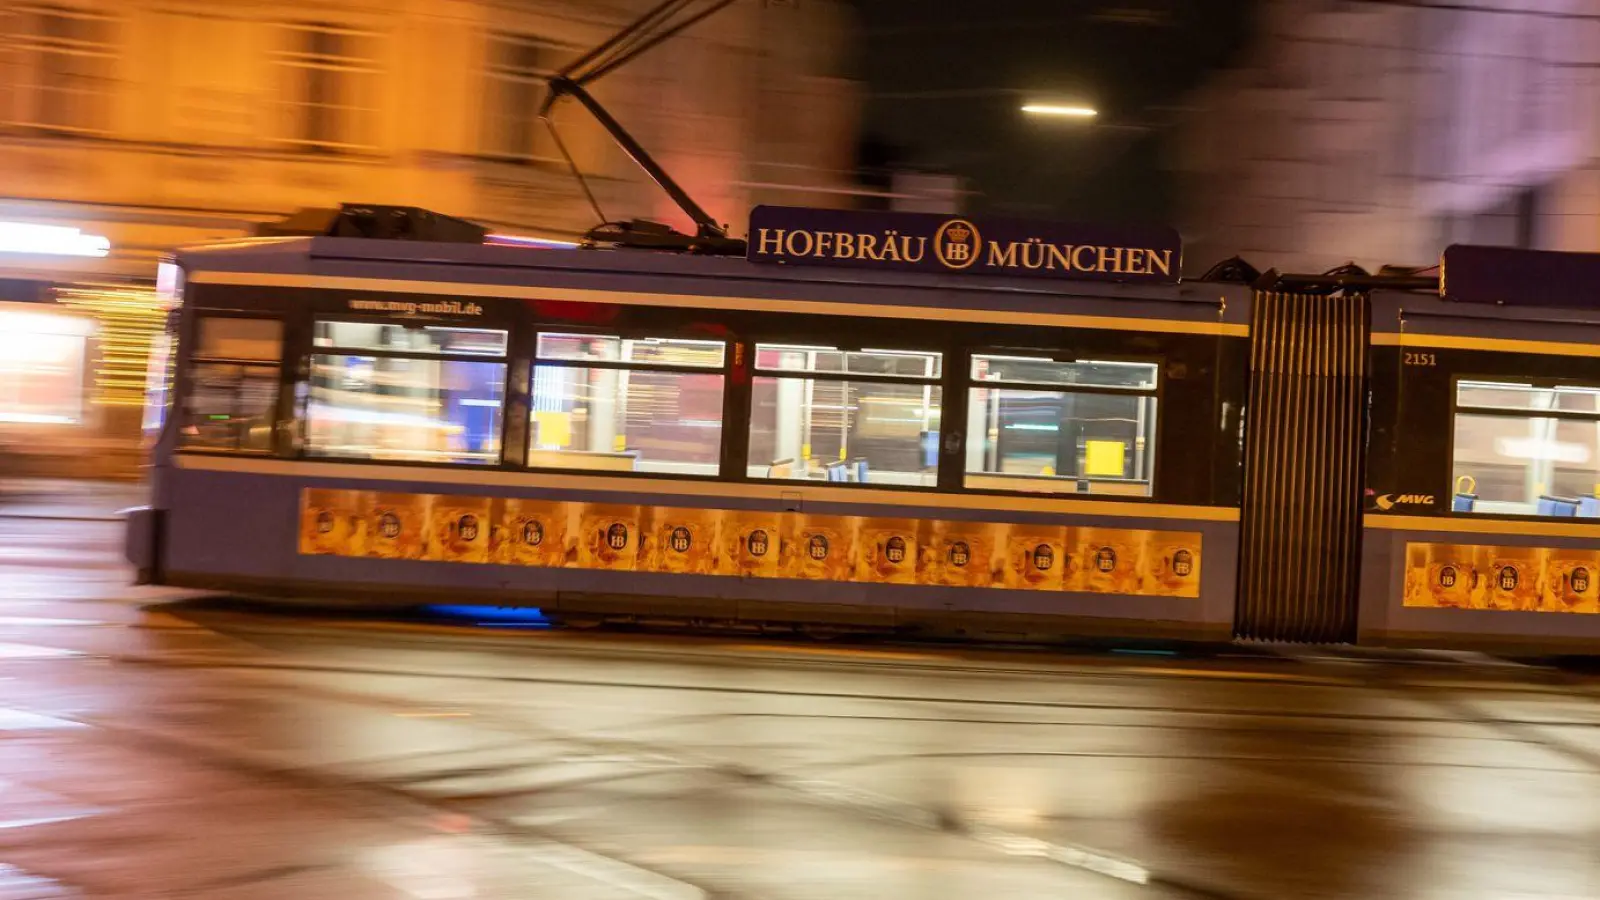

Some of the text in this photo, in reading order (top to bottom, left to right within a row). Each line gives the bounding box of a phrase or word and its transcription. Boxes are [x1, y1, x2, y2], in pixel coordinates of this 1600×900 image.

[757, 229, 1172, 276] HOFBRÄU HB MÜNCHEN
[1404, 353, 1436, 366] 2151
[1396, 494, 1434, 504] MVG
